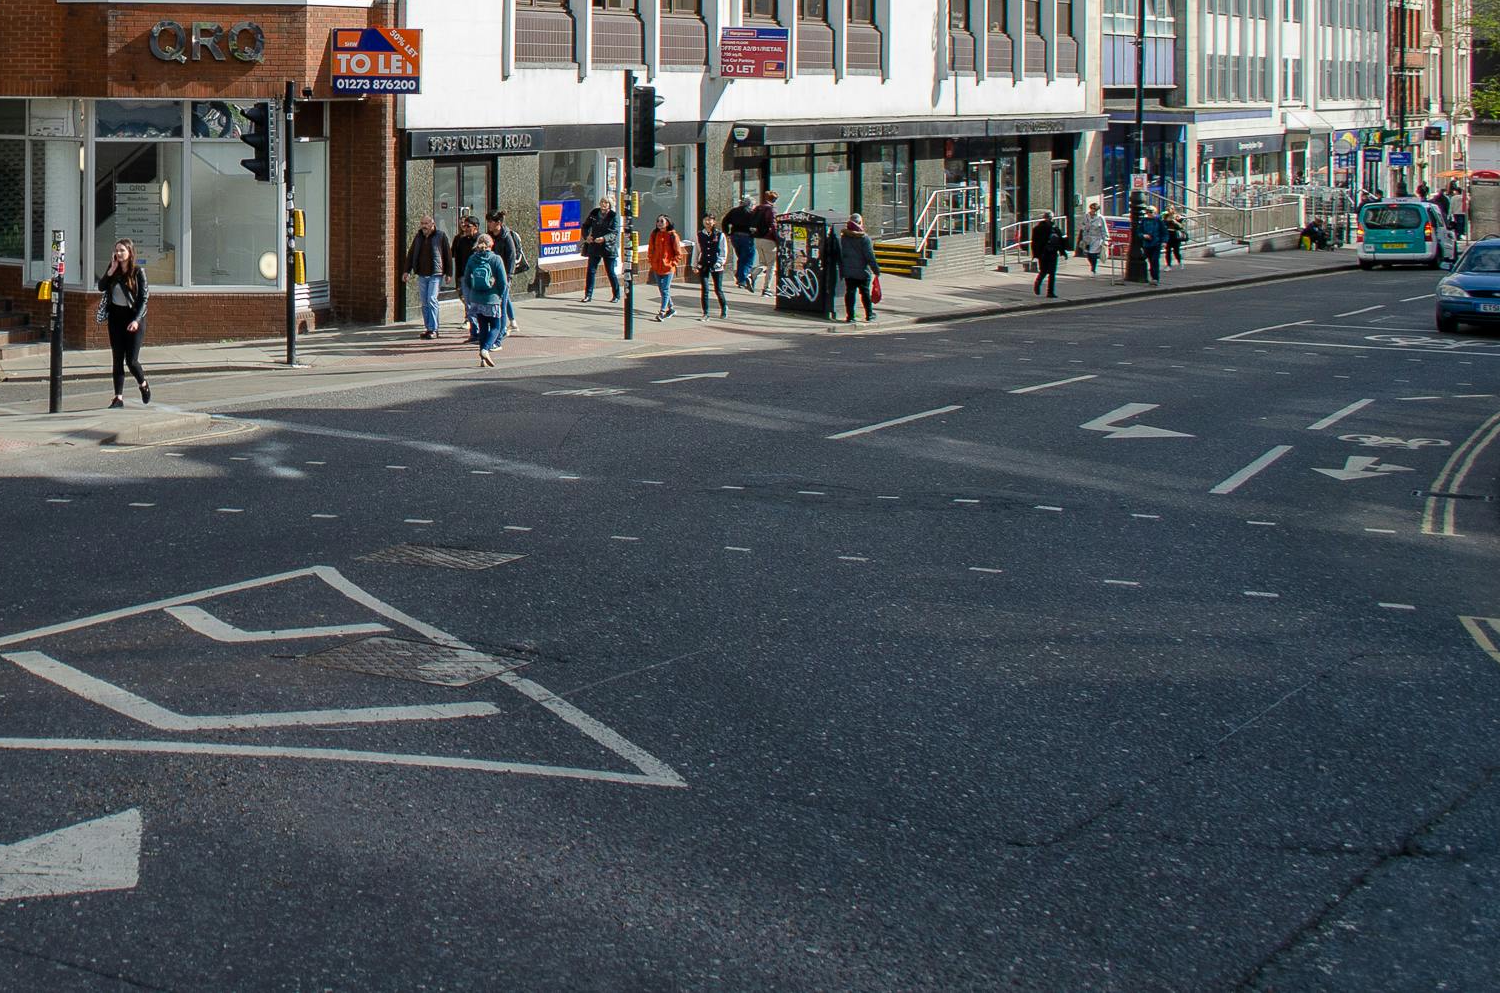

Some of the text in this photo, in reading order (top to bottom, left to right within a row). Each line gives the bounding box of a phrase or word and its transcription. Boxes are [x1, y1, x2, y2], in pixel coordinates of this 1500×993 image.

[149, 20, 265, 64] QRQ
[389, 29, 419, 58] 50% LET
[337, 53, 371, 74] TO
[721, 64, 734, 73] TO
[736, 65, 756, 74] LET
[336, 79, 416, 90] 01273 876200
[461, 135, 502, 150] QUEENS
[505, 134, 532, 148] ROAD
[551, 231, 572, 242] TO LET
[544, 246, 560, 255] 01273
